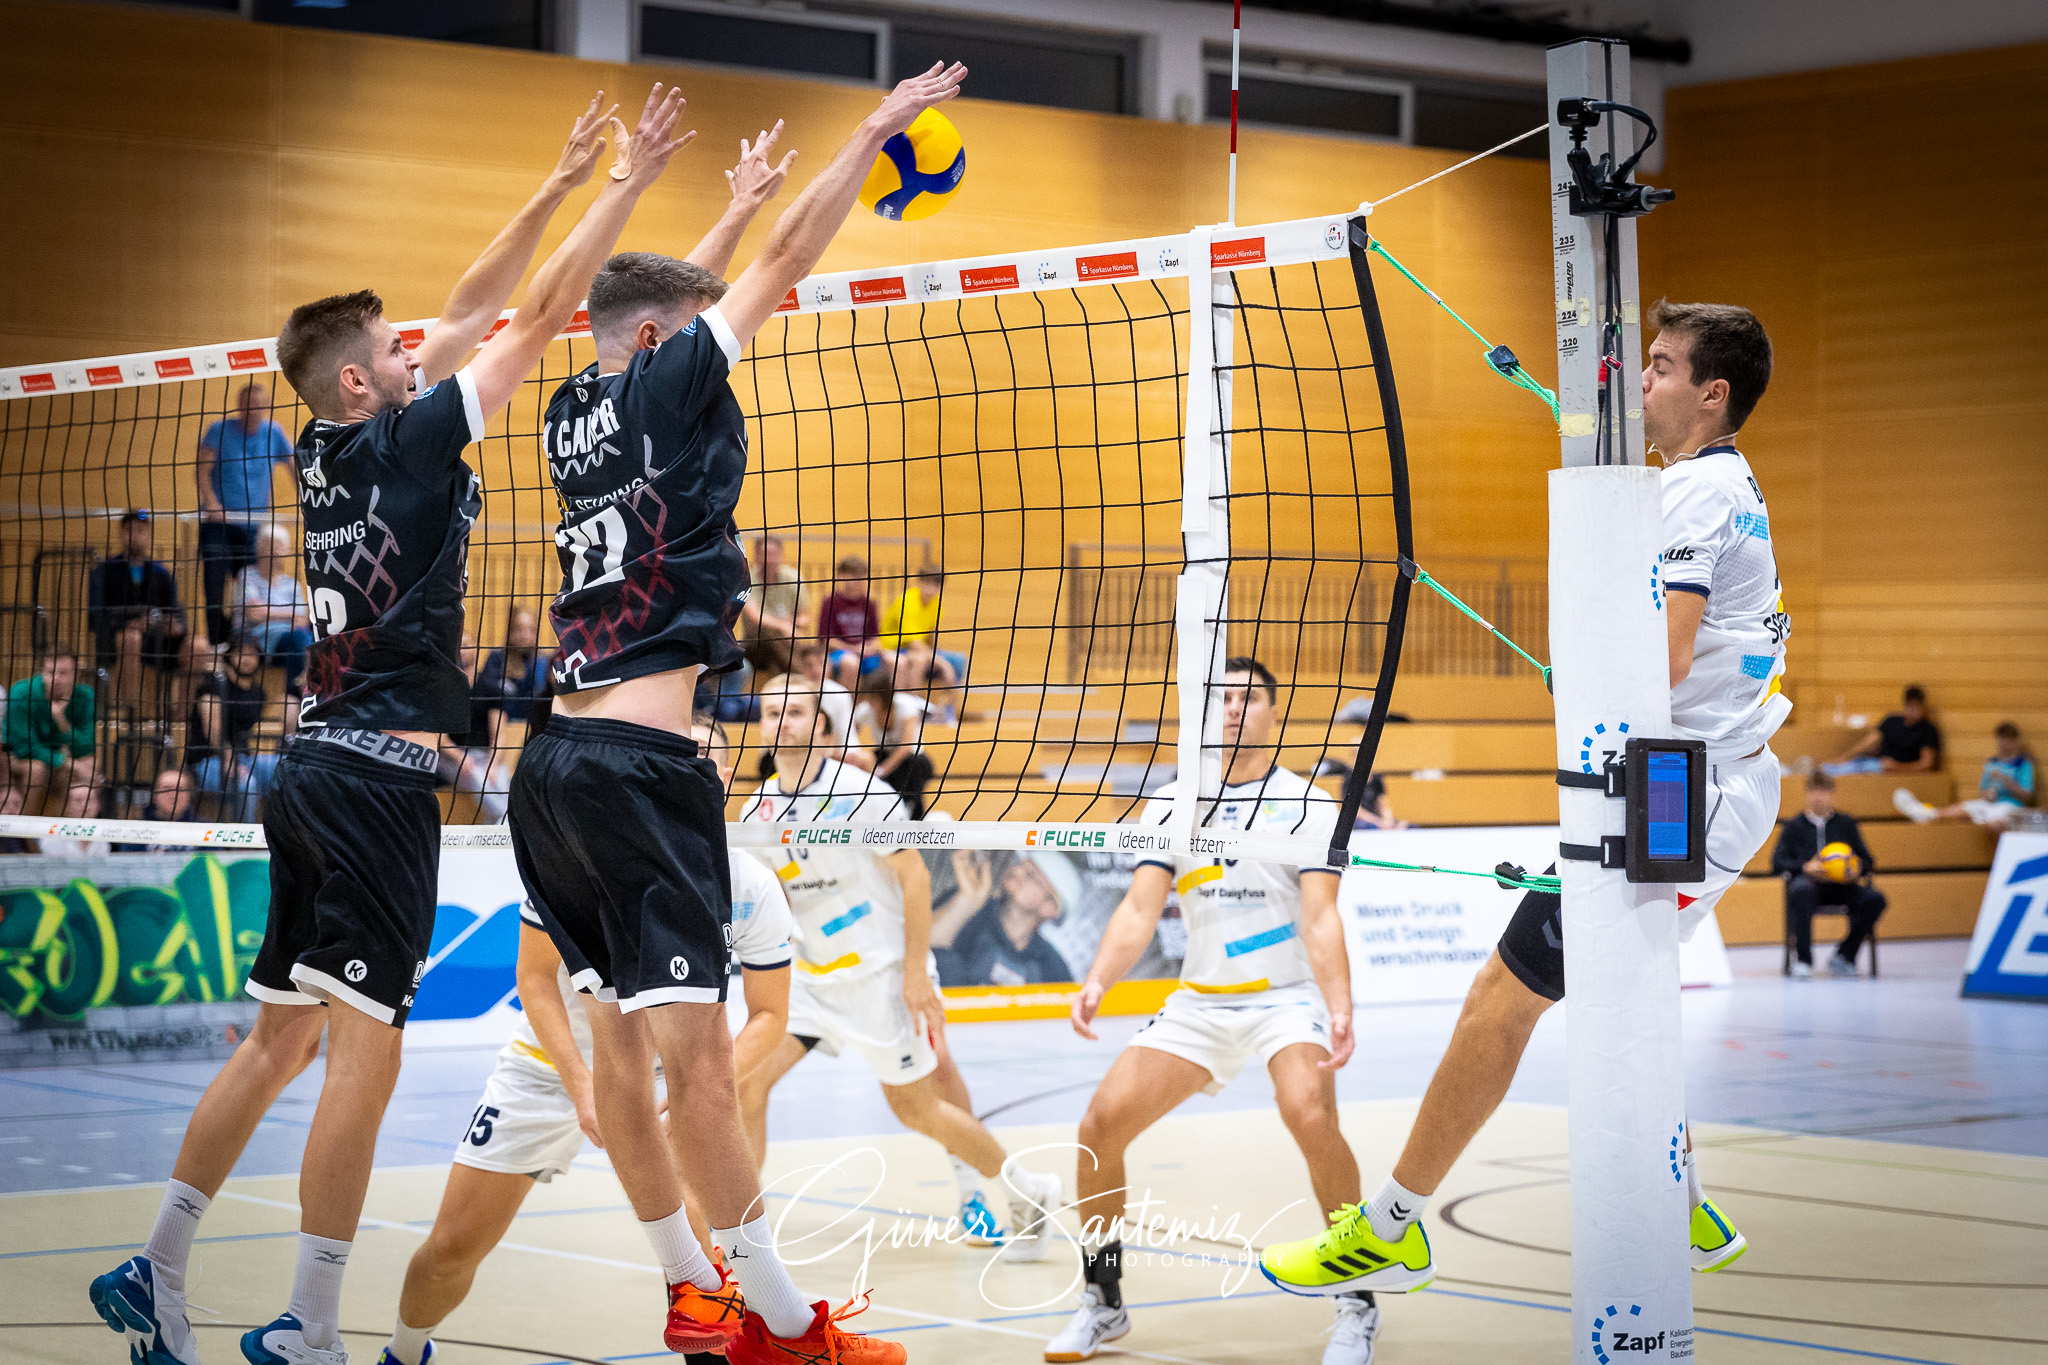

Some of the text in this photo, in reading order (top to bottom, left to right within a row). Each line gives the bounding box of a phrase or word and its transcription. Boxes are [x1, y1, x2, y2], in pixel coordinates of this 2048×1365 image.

[1559, 235, 1575, 246] 235
[1213, 249, 1261, 261] Sparkasse Nürnberg
[1089, 265, 1112, 275] Sparkasse
[1112, 263, 1134, 273] Nürnberg
[1164, 258, 1179, 268] Zapf
[972, 277, 995, 287] Sparkasse
[995, 275, 1015, 285] Nürnberg
[1043, 271, 1057, 280] Zapf
[861, 288, 882, 298] Sparkasse
[882, 287, 902, 296] Nürnberg
[928, 283, 942, 291] Zapf
[820, 294, 833, 302] Zapf
[1561, 310, 1577, 320] 224
[1562, 338, 1578, 348] 220
[305, 520, 366, 550] SEHRING
[378, 734, 437, 771] PRO
[1602, 750, 1627, 768] Za
[58, 824, 97, 836] FUCHS
[213, 830, 255, 842] FUCHS
[440, 832, 465, 846] deen
[796, 828, 955, 845] FUCHS Ideen umsetzen
[1043, 830, 1106, 847] FUCHS
[1118, 831, 1154, 849] Ideen
[1612, 1330, 1665, 1355] Zapf
